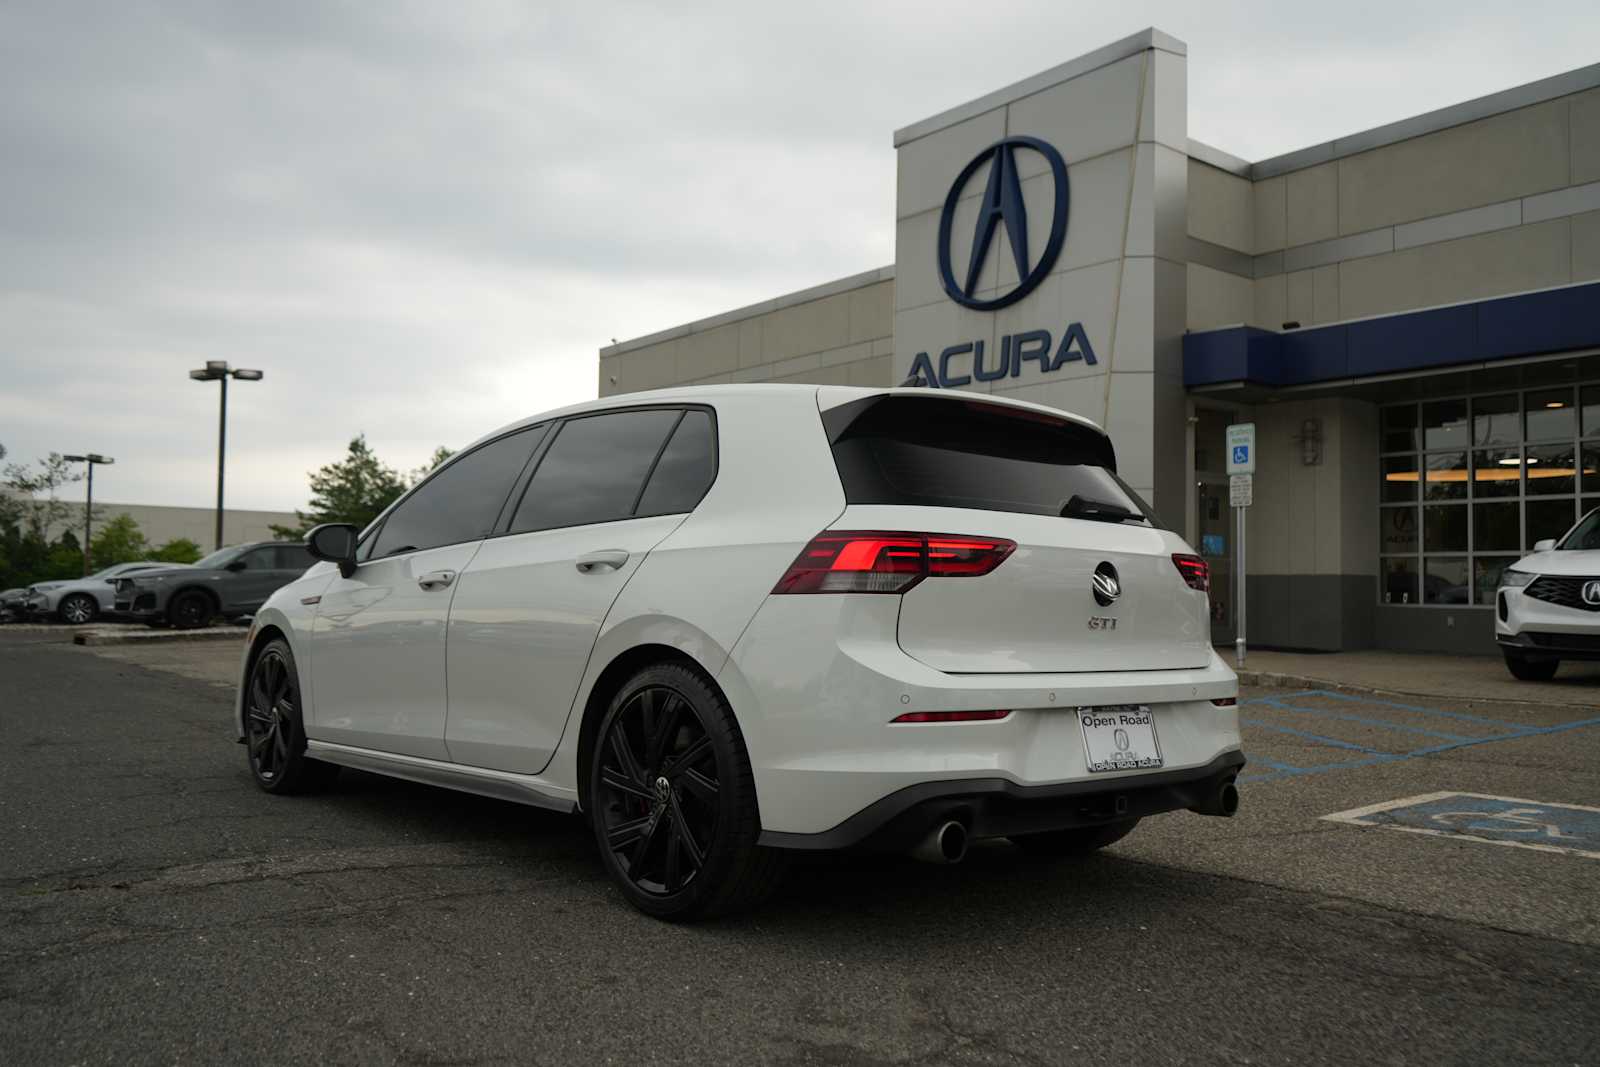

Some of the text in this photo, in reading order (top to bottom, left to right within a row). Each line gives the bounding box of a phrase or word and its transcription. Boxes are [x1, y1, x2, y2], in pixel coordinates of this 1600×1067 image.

[906, 322, 1098, 389] ACURA
[1088, 616, 1118, 631] GTI
[1082, 715, 1150, 728] Open Road
